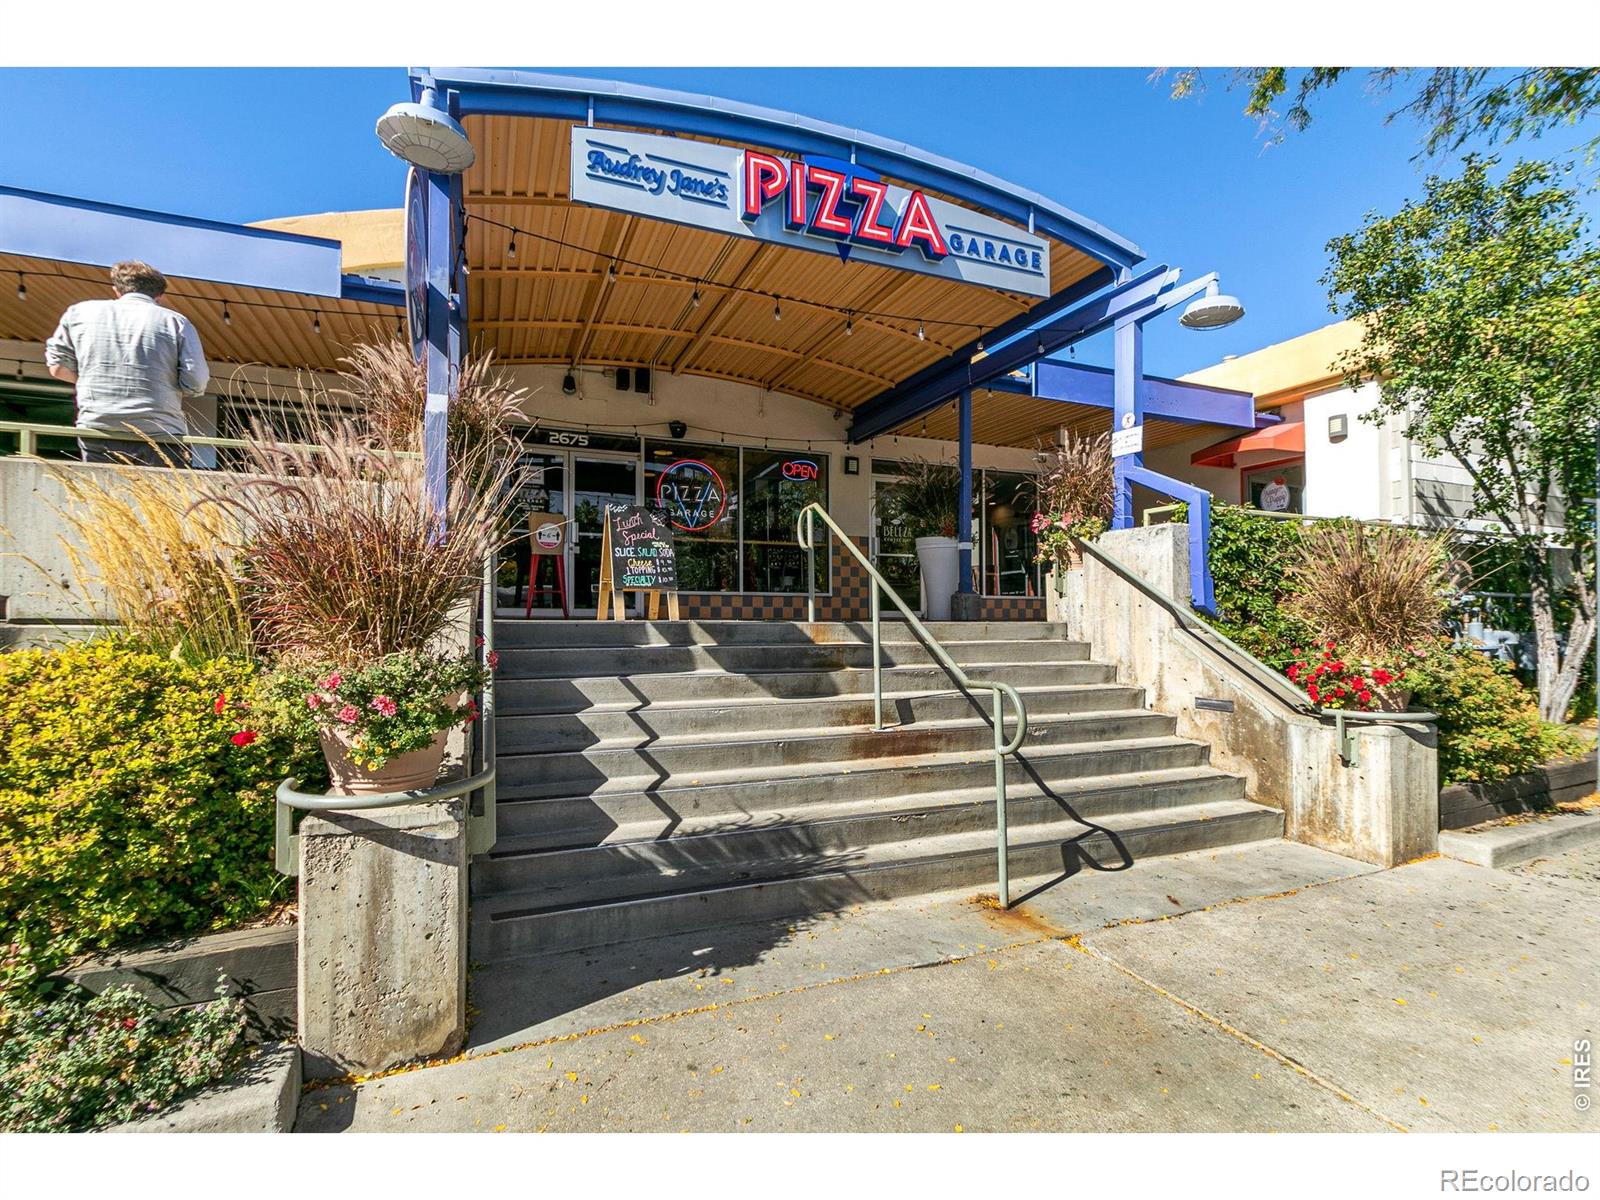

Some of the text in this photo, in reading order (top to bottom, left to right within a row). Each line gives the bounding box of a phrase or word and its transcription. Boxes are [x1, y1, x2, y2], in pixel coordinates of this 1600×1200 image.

[586, 150, 729, 201] Audrey Jane's
[741, 150, 949, 263] PIZZA
[949, 233, 1043, 271] GARAGE
[548, 432, 589, 446] 2675
[782, 462, 818, 480] OPEN
[660, 485, 721, 502] PIZZA
[670, 508, 715, 518] GARAGE
[613, 513, 643, 532] Lunch
[622, 528, 660, 546] Special
[637, 547, 658, 557] SALAD
[658, 547, 675, 558] SODA
